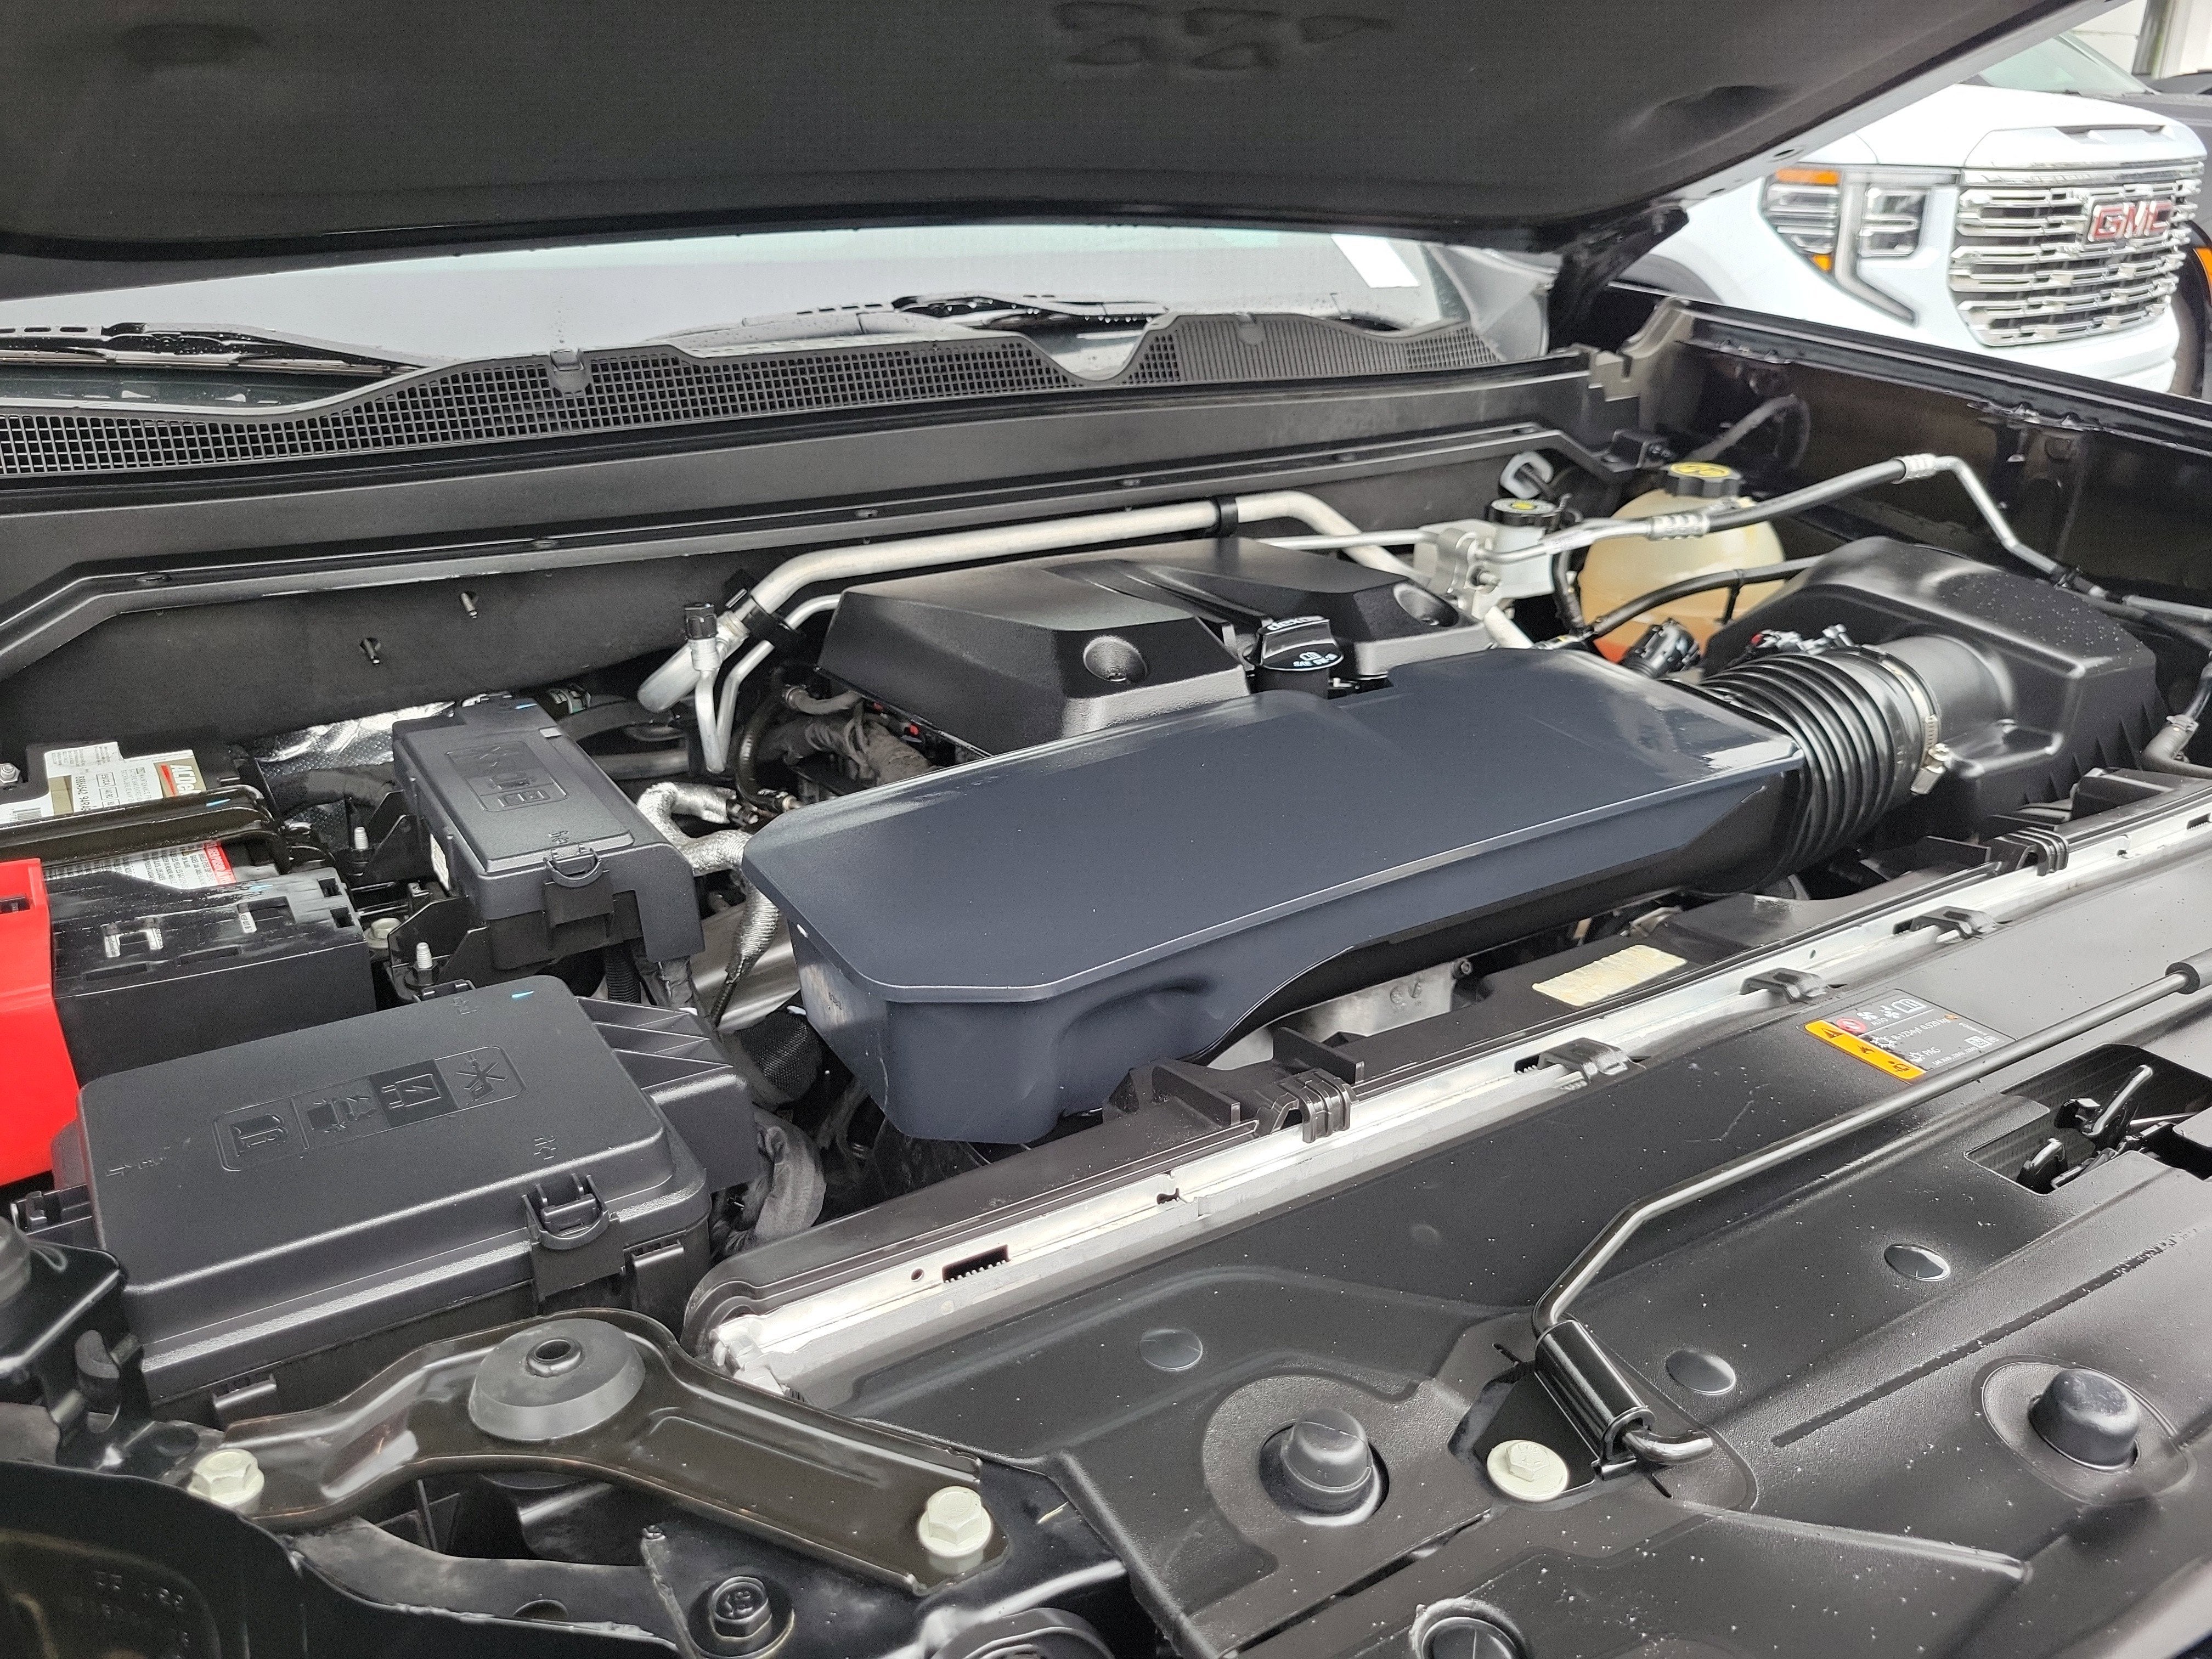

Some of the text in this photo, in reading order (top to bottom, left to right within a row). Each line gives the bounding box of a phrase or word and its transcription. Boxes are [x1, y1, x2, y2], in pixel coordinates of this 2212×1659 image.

[2087, 200, 2174, 241] GMC
[1870, 1018, 1888, 1026] AUTO
[1922, 1047, 1942, 1057] PAG
